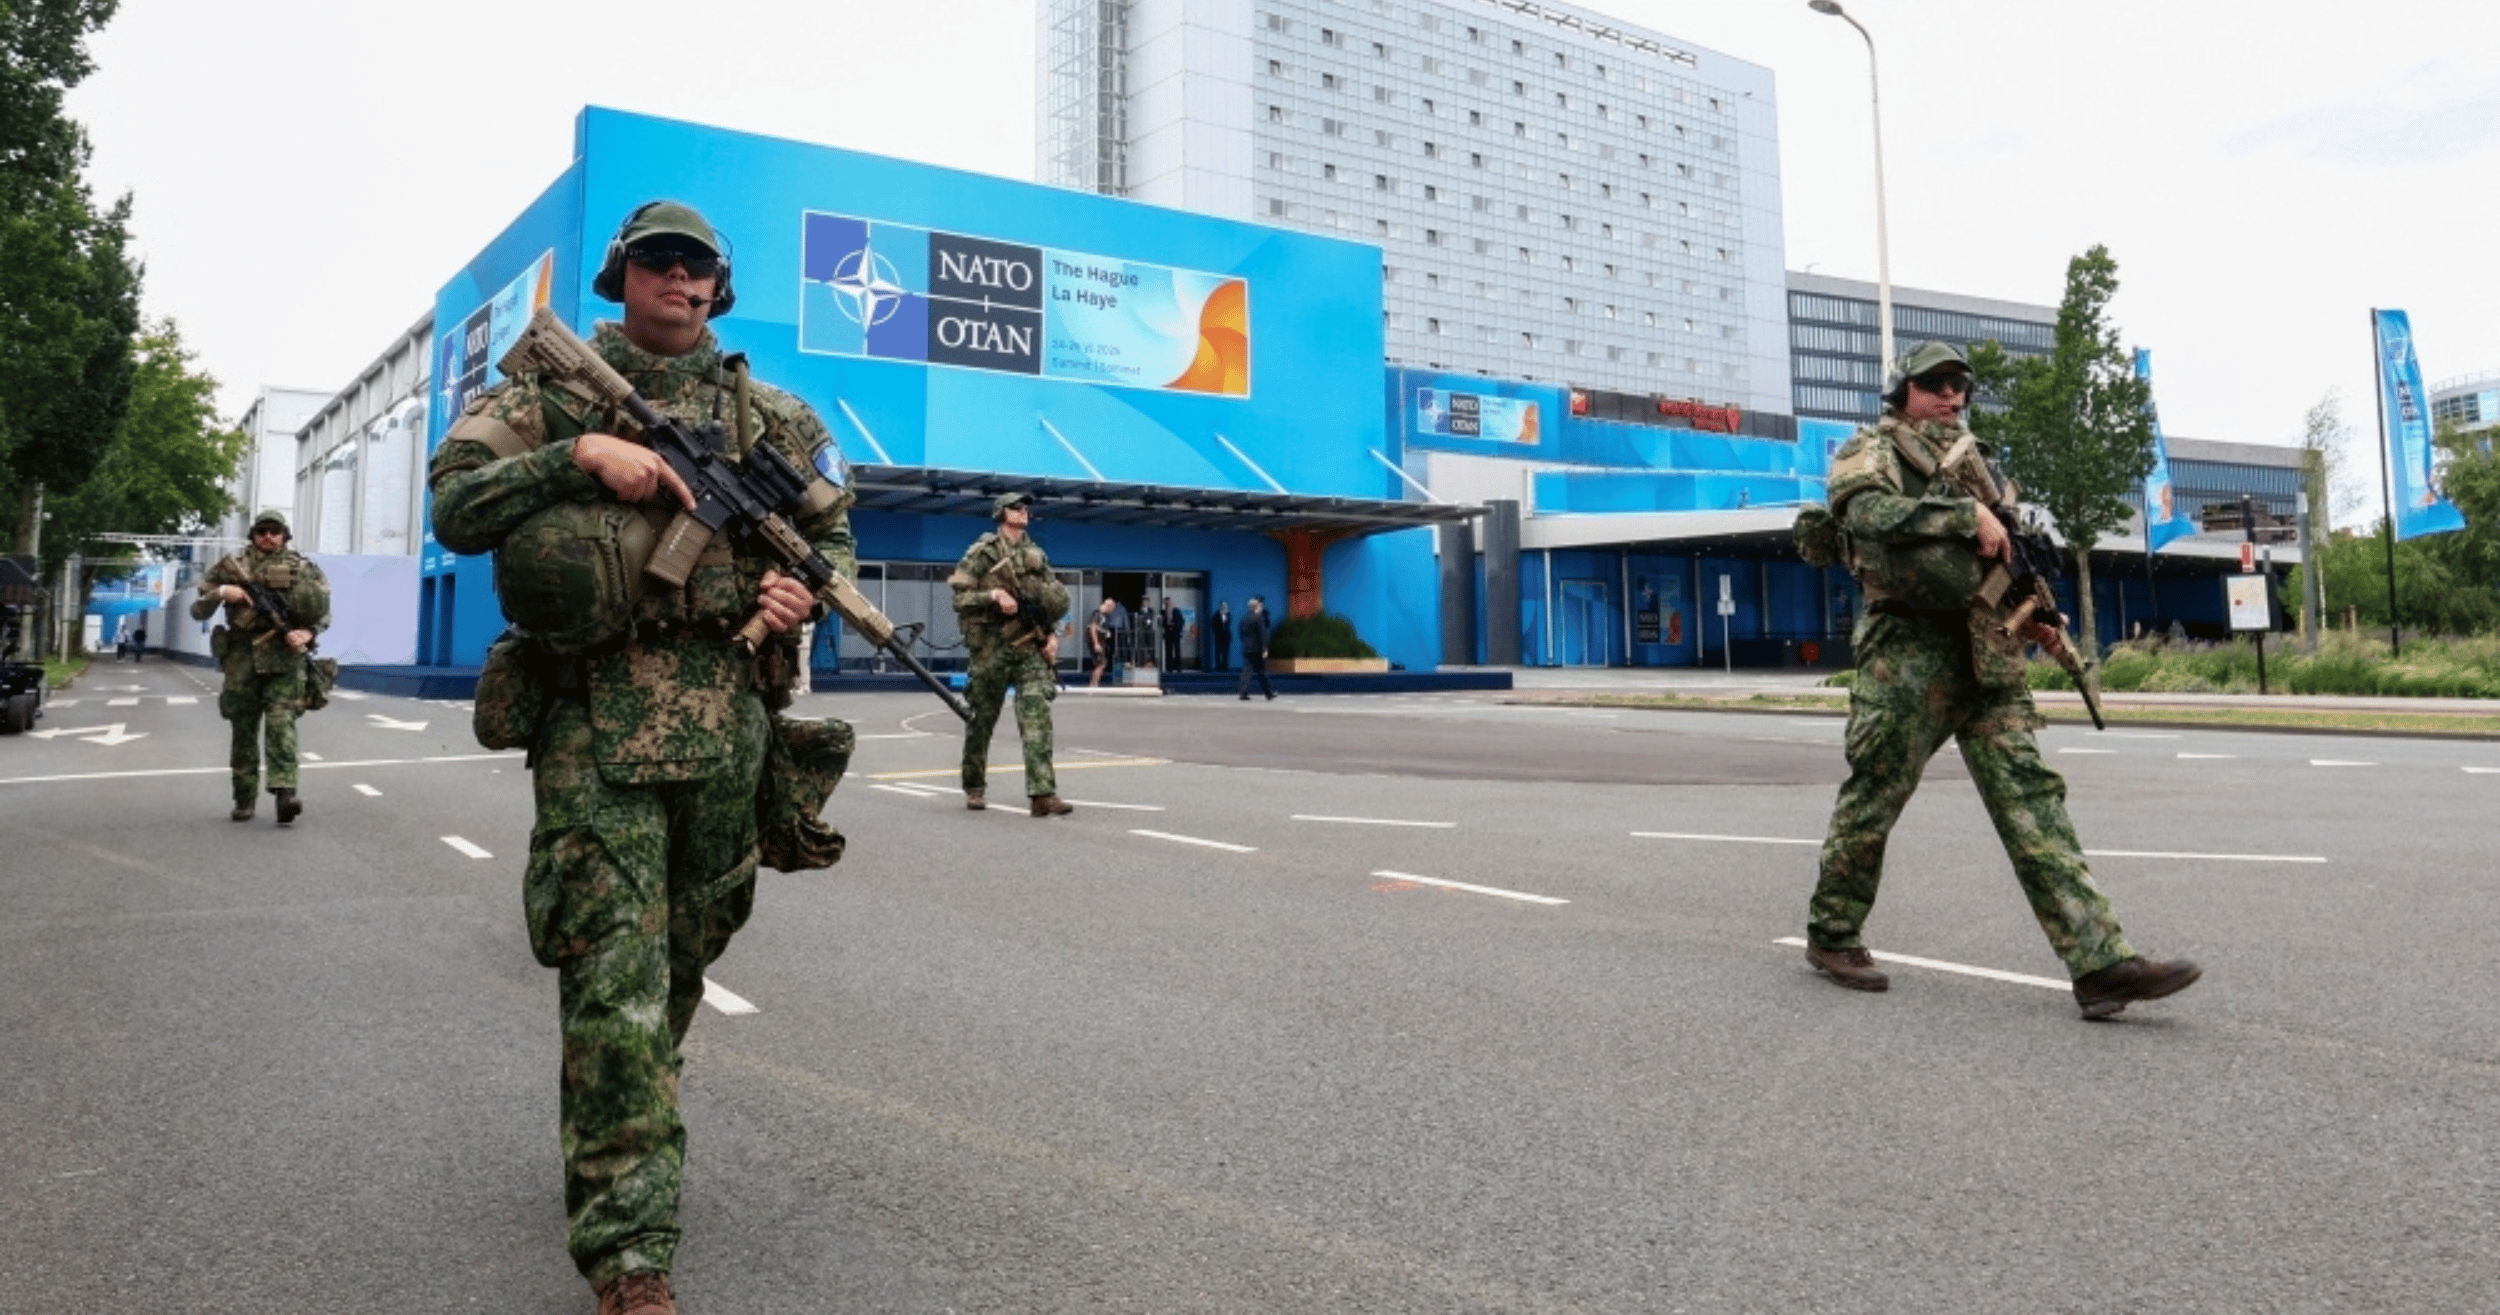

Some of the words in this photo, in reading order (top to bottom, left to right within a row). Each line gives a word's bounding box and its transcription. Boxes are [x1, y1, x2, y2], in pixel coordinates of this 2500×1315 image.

[938, 249, 1033, 291] NATO
[1052, 259, 1083, 278] The
[1087, 265, 1139, 289] Hague
[1052, 285, 1071, 302] La
[1077, 289, 1118, 311] Haye
[937, 316, 1033, 356] OTAN
